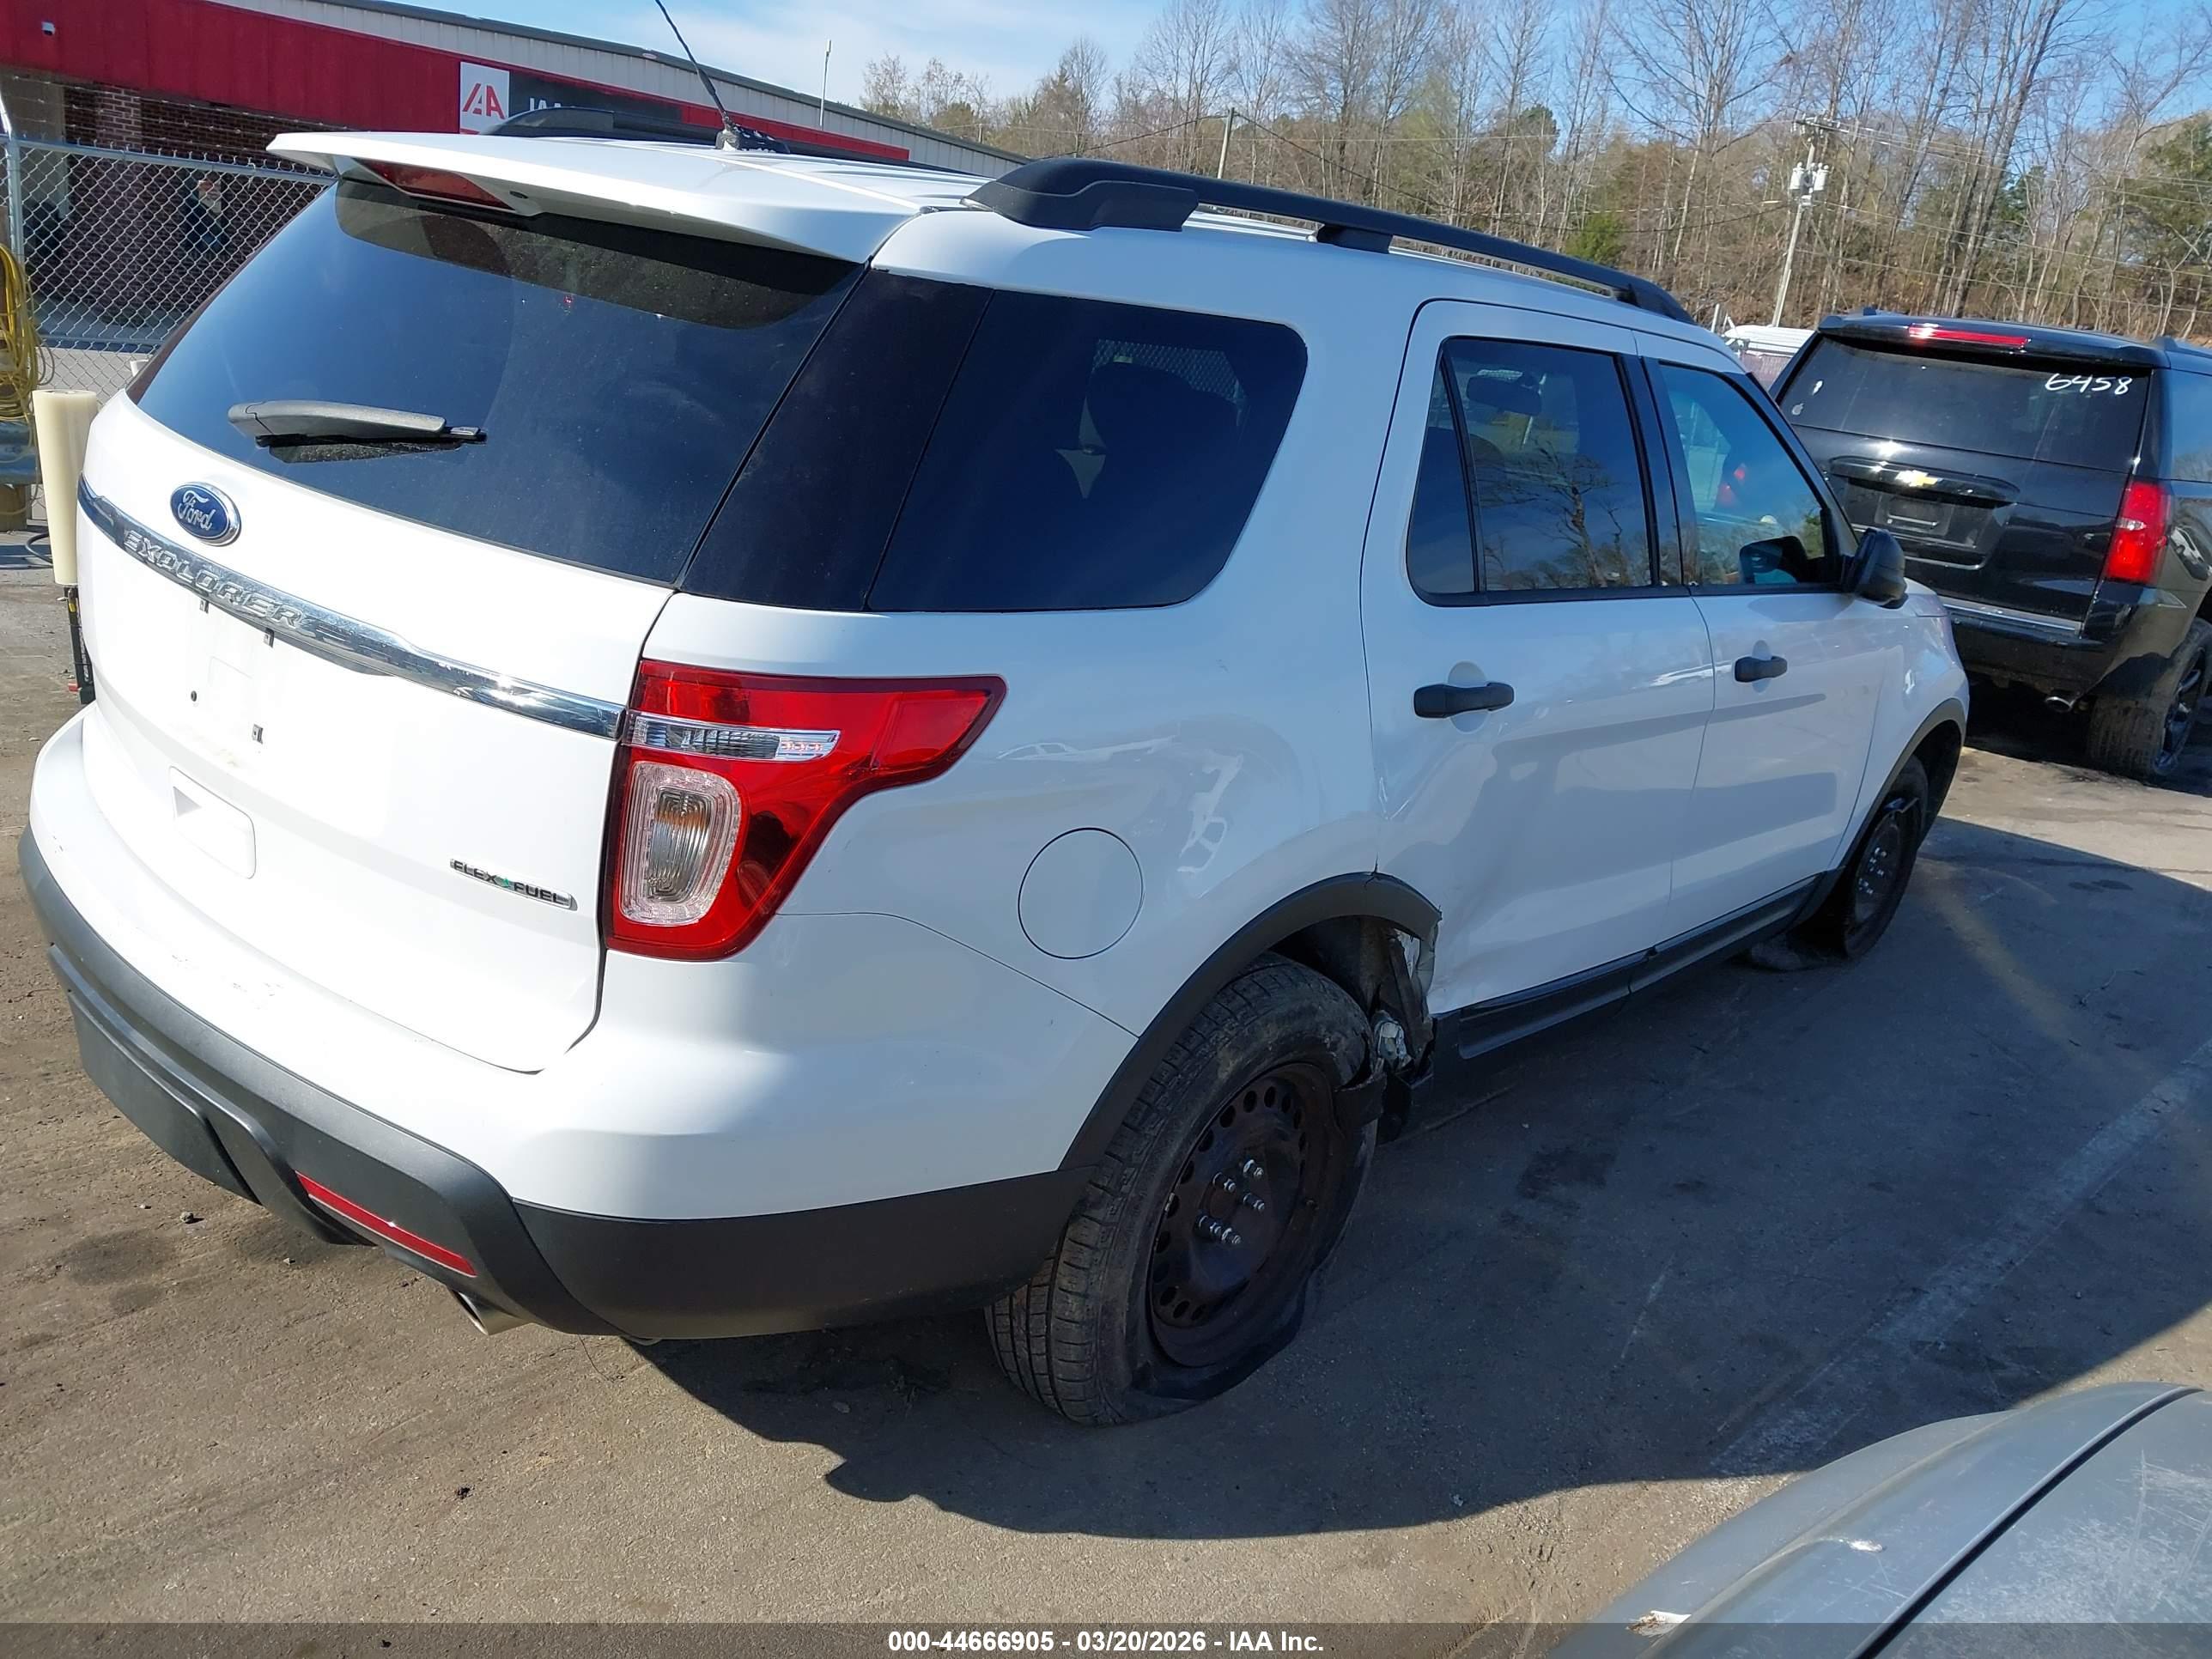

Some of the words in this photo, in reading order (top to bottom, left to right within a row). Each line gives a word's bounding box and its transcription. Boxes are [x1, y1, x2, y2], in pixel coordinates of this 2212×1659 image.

[2044, 373, 2133, 395] 6458
[177, 489, 217, 531] Ford
[123, 529, 304, 629] EXPLORER
[453, 859, 499, 885] FLEX
[514, 881, 565, 905] FUEL
